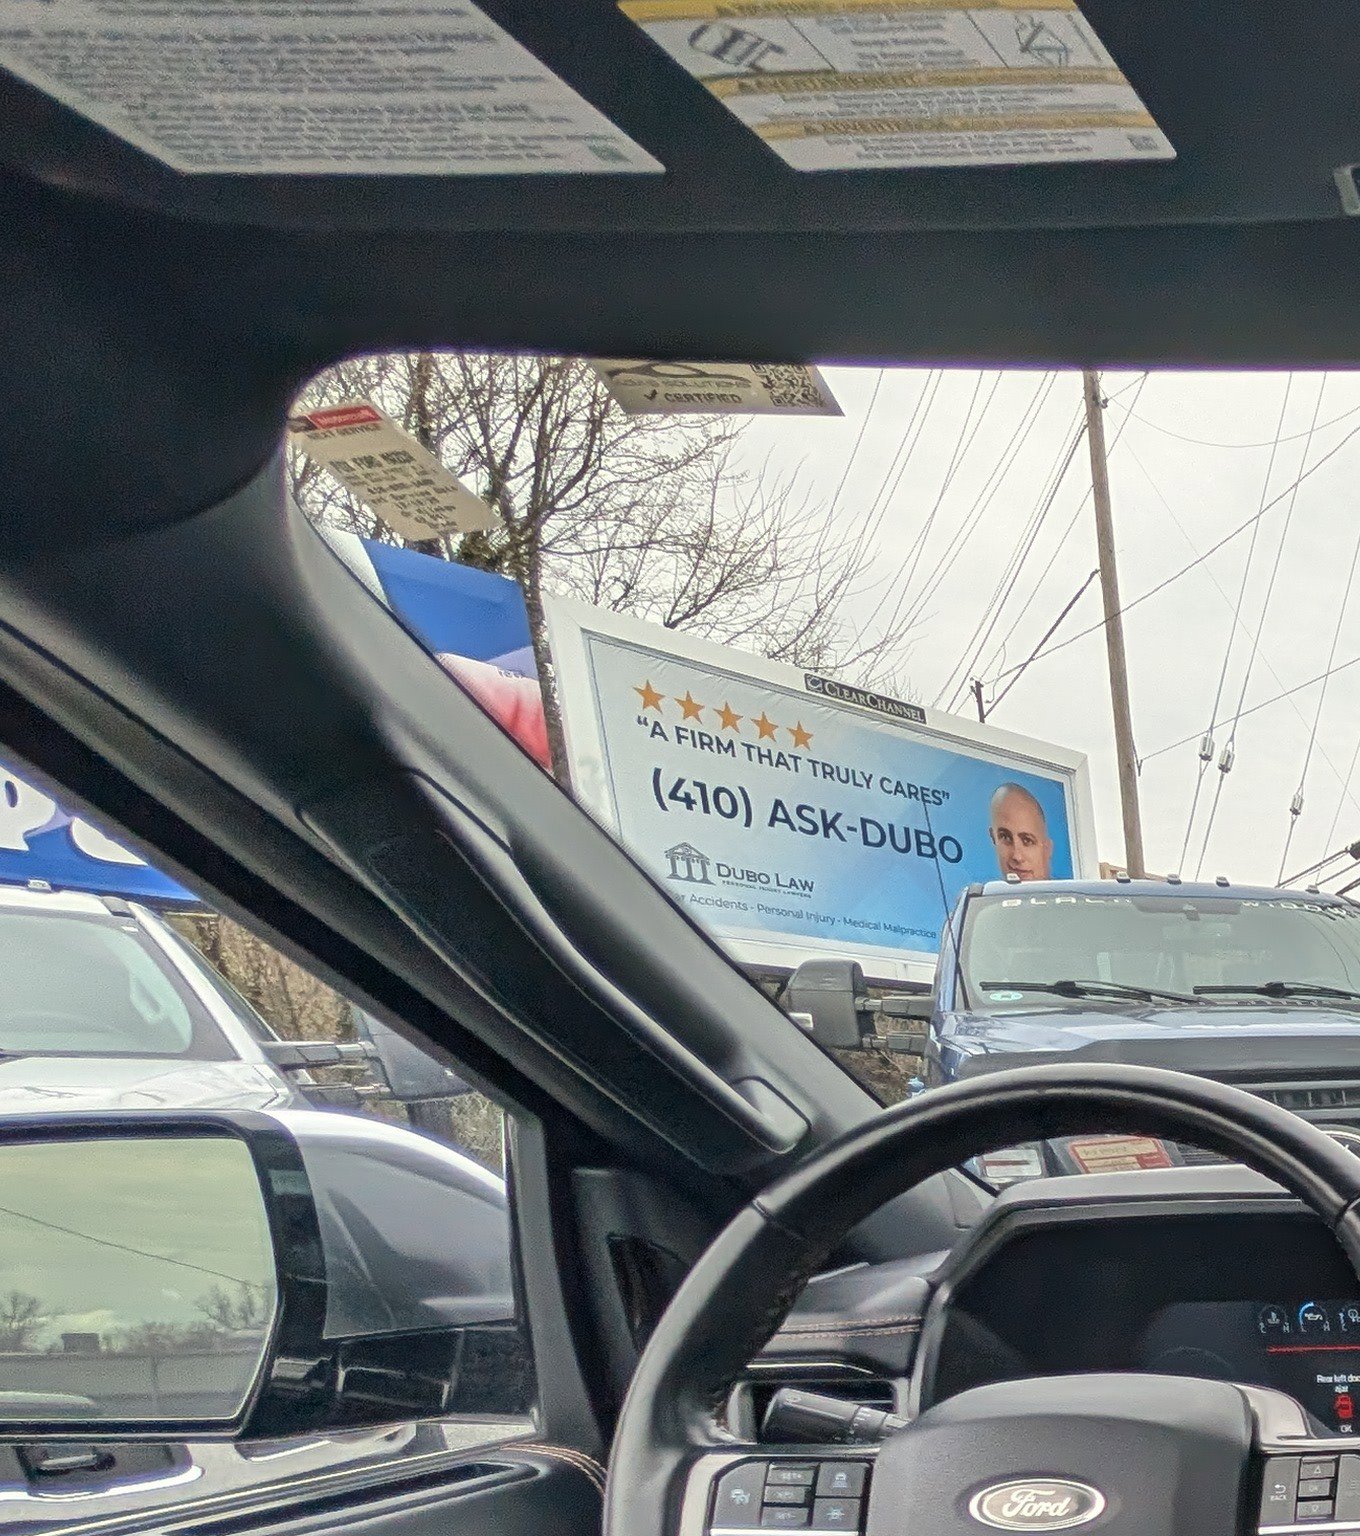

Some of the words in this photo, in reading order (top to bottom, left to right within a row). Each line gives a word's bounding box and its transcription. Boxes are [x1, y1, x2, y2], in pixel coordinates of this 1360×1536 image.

[664, 392, 743, 405] CERTIFIED
[675, 724, 737, 758] FIRM
[740, 741, 802, 773] THAT
[807, 758, 874, 790] TRULY
[652, 767, 753, 828] (410)
[767, 798, 964, 864] ASK-DUBO
[715, 862, 771, 886] DUBO
[775, 871, 815, 894] LAW
[689, 892, 749, 912] Accidents
[757, 904, 805, 920] Personal
[806, 911, 836, 927] Injury
[843, 916, 882, 932] Medical
[883, 923, 937, 940] Malpractice
[1316, 1374, 1333, 1384] Rear
[1333, 1374, 1347, 1383] left
[1340, 1424, 1353, 1433] OK
[1002, 1488, 1072, 1517] Ford
